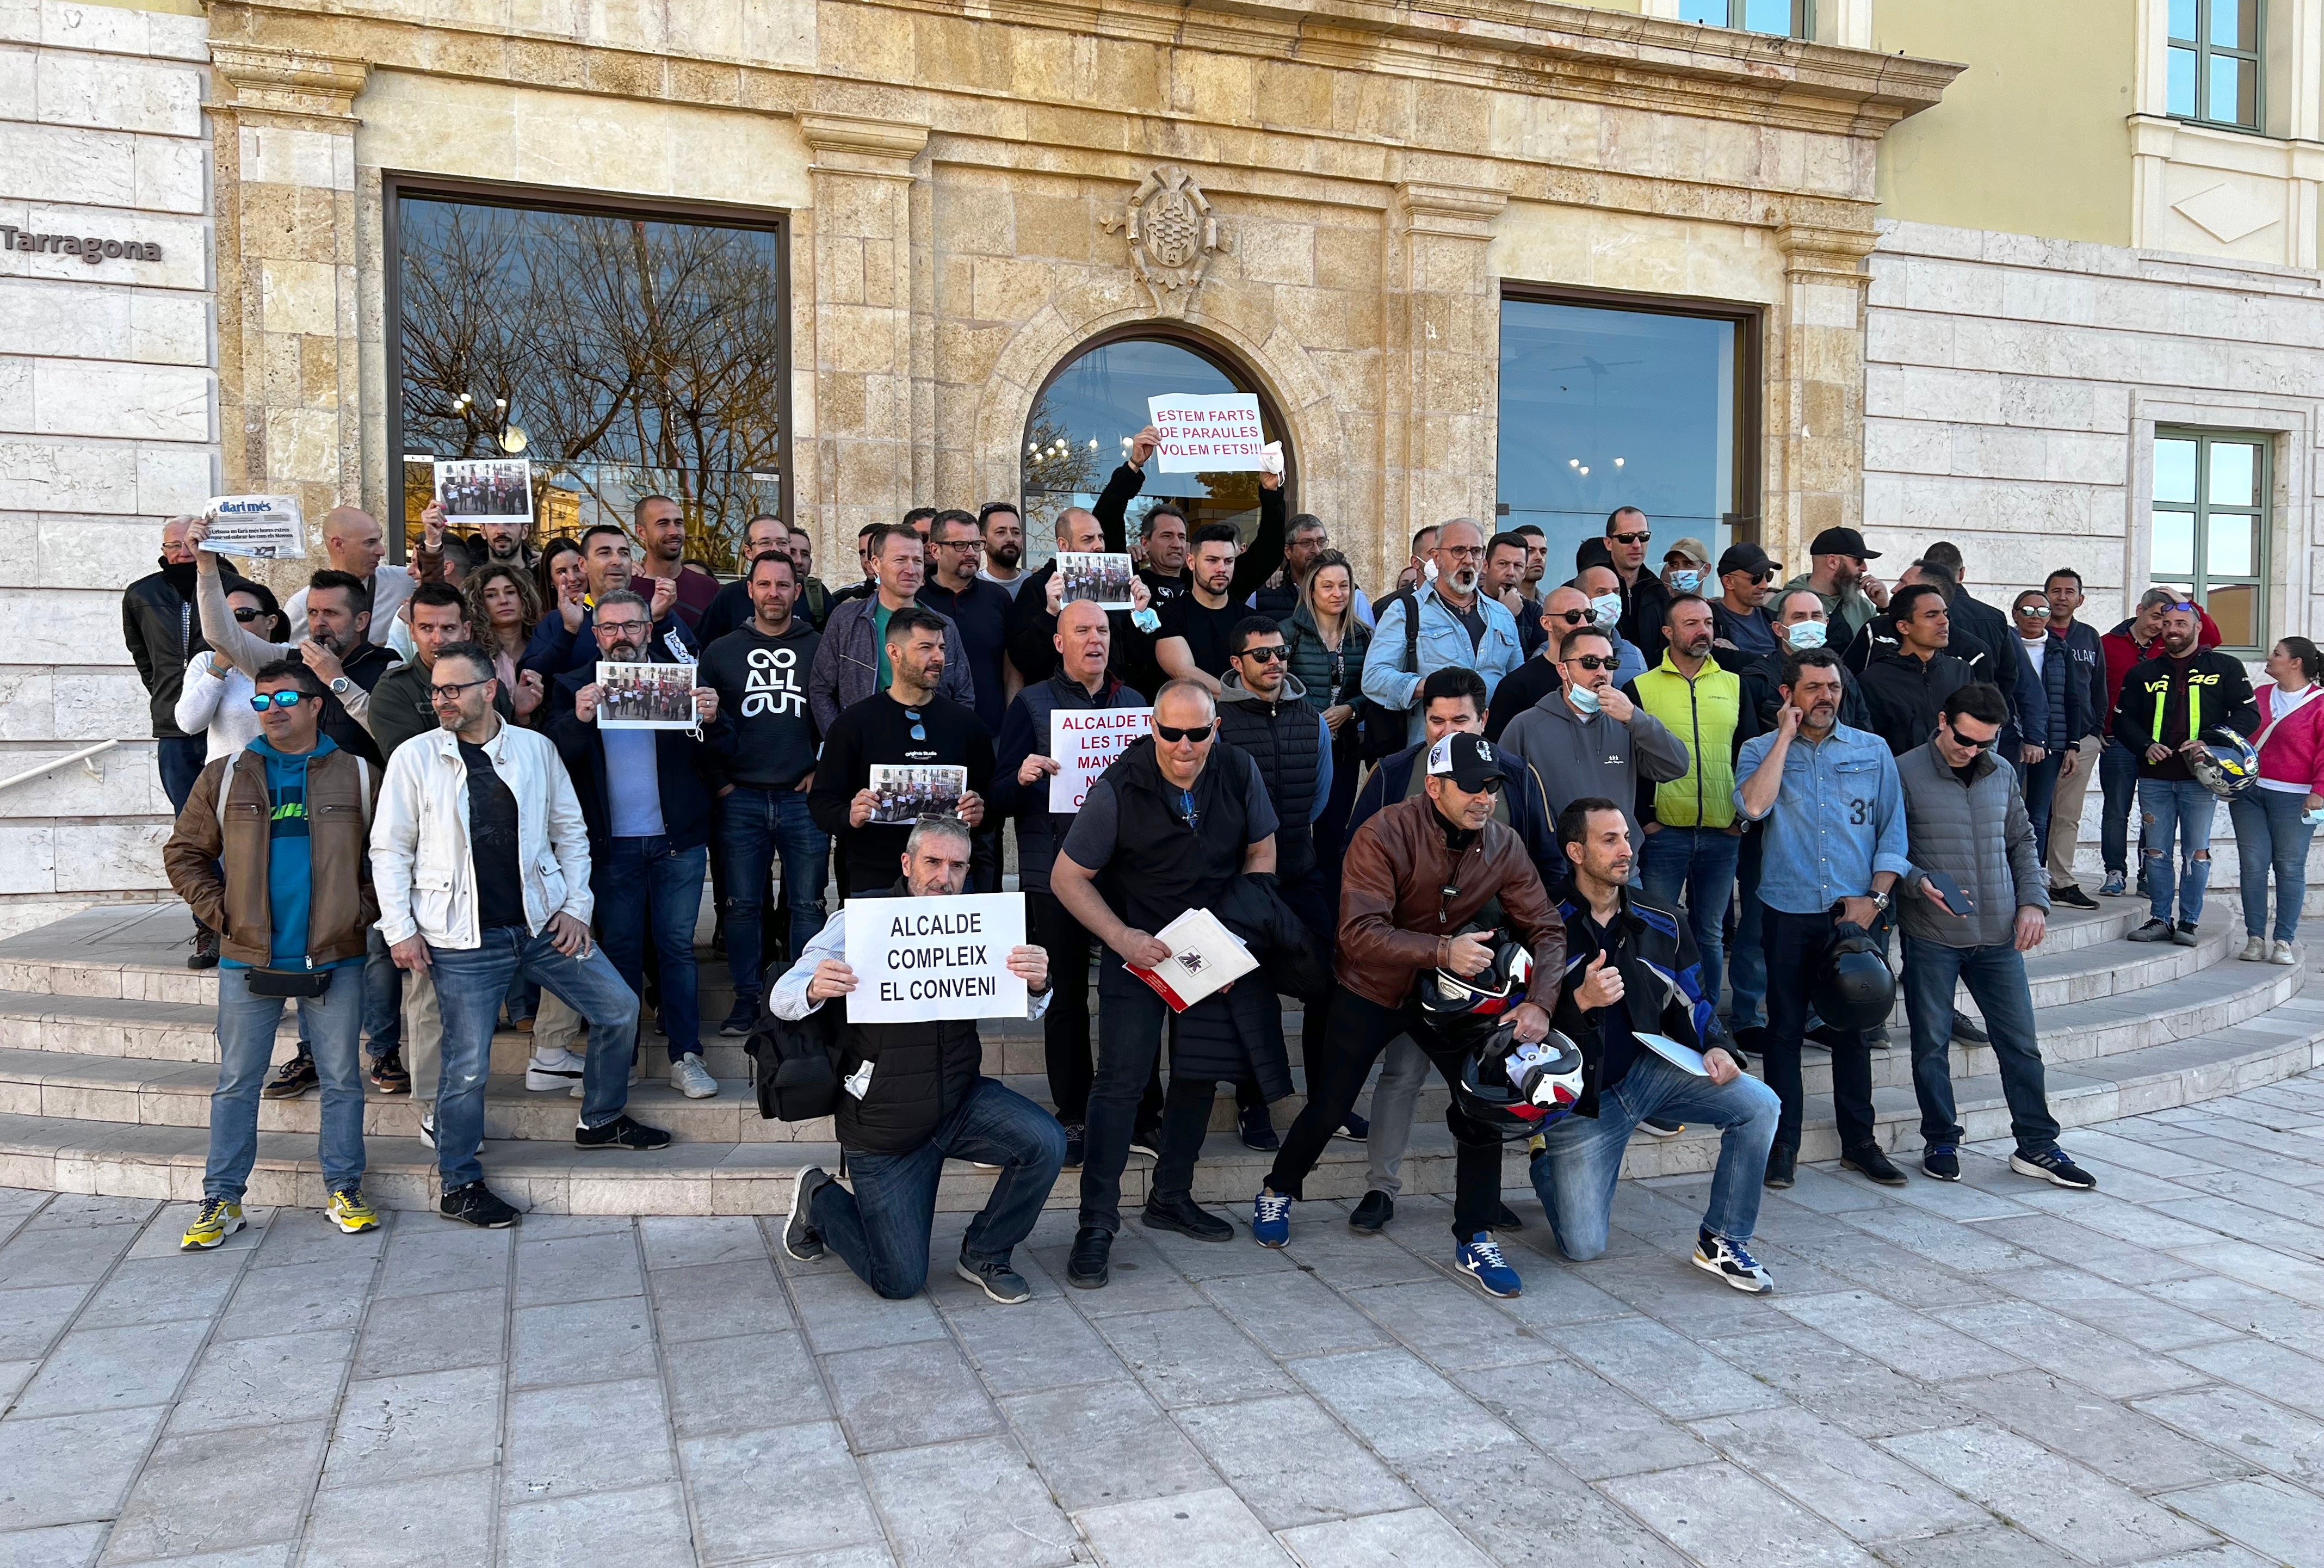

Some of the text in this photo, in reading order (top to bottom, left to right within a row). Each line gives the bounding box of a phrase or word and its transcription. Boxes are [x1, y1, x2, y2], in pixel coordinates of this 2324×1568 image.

[0, 225, 162, 264] Tarragona
[1157, 410, 1255, 422] ESTEM FARTS
[1159, 427, 1258, 439] DE PARAULES
[1159, 443, 1262, 455] VOLEM FETS!!!
[219, 501, 271, 513] diari més
[747, 648, 796, 669] GO
[745, 669, 801, 692] ALL
[2144, 674, 2220, 693] VR 46
[741, 692, 807, 718] OUT
[1062, 714, 1151, 730] ALCALDE T
[1081, 736, 1110, 749] LES
[1086, 775, 1096, 788] N
[1073, 794, 1085, 807] C
[1850, 798, 1875, 825] 31
[891, 913, 981, 937] ALCALDE
[888, 945, 987, 970] COMPLEIX
[880, 976, 996, 1001] EL CONVENI
